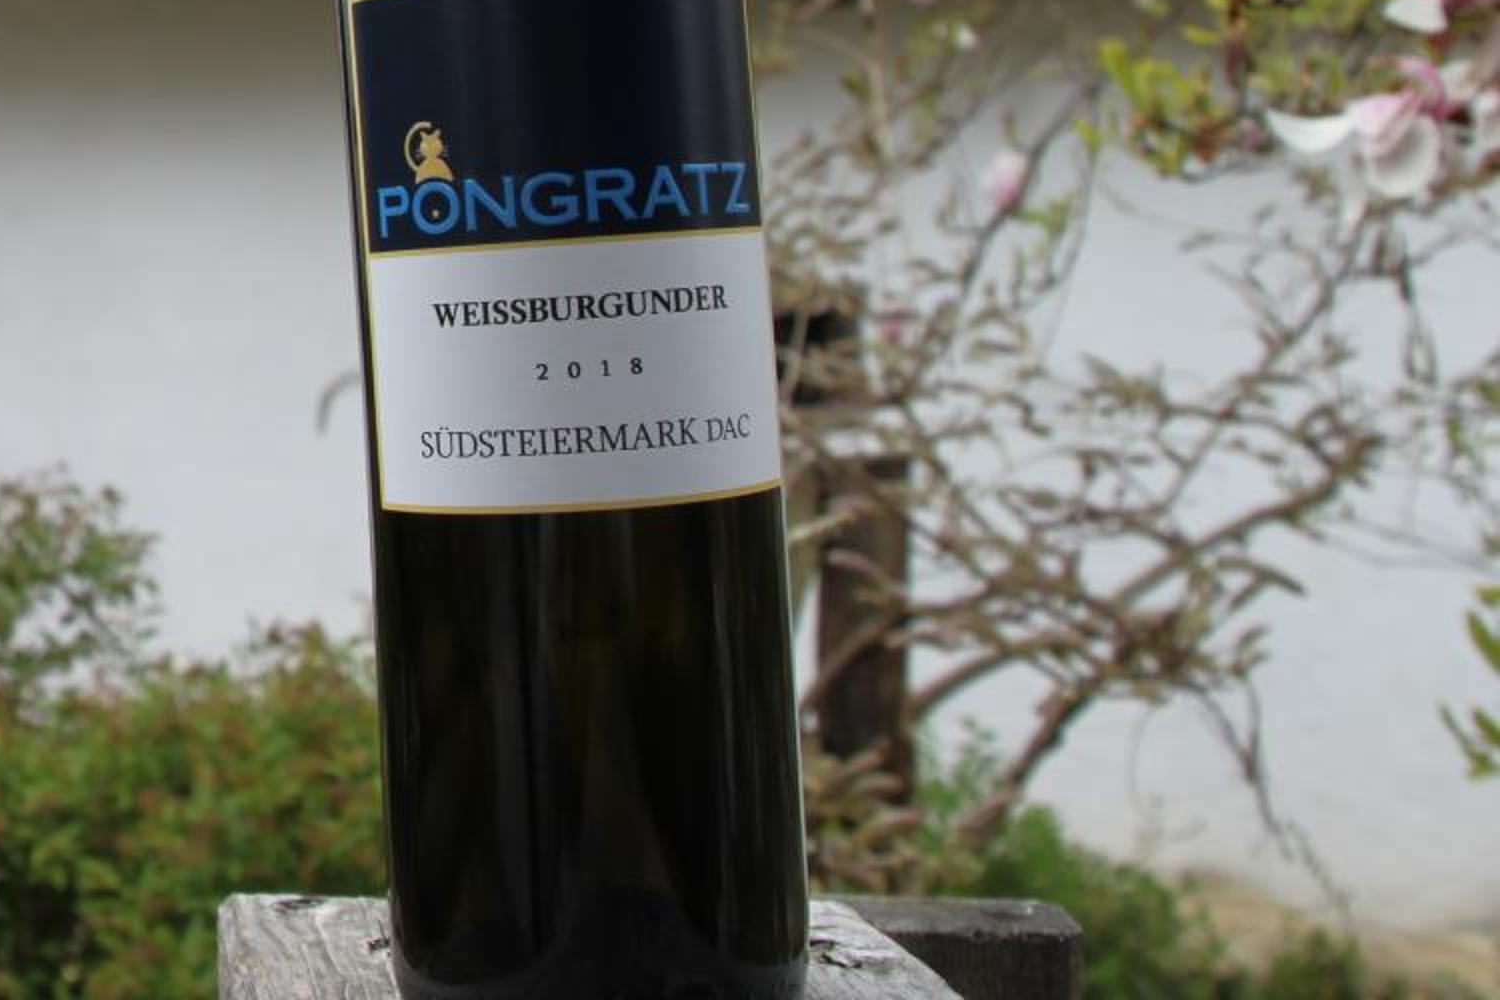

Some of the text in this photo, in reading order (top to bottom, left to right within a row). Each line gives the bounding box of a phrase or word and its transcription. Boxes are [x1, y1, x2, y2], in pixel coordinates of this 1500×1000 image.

[377, 162, 751, 239] PONGRATZ
[432, 285, 728, 328] WEISSBURGUNDER
[420, 413, 752, 460] SÜDSTEIERMARK DAC
